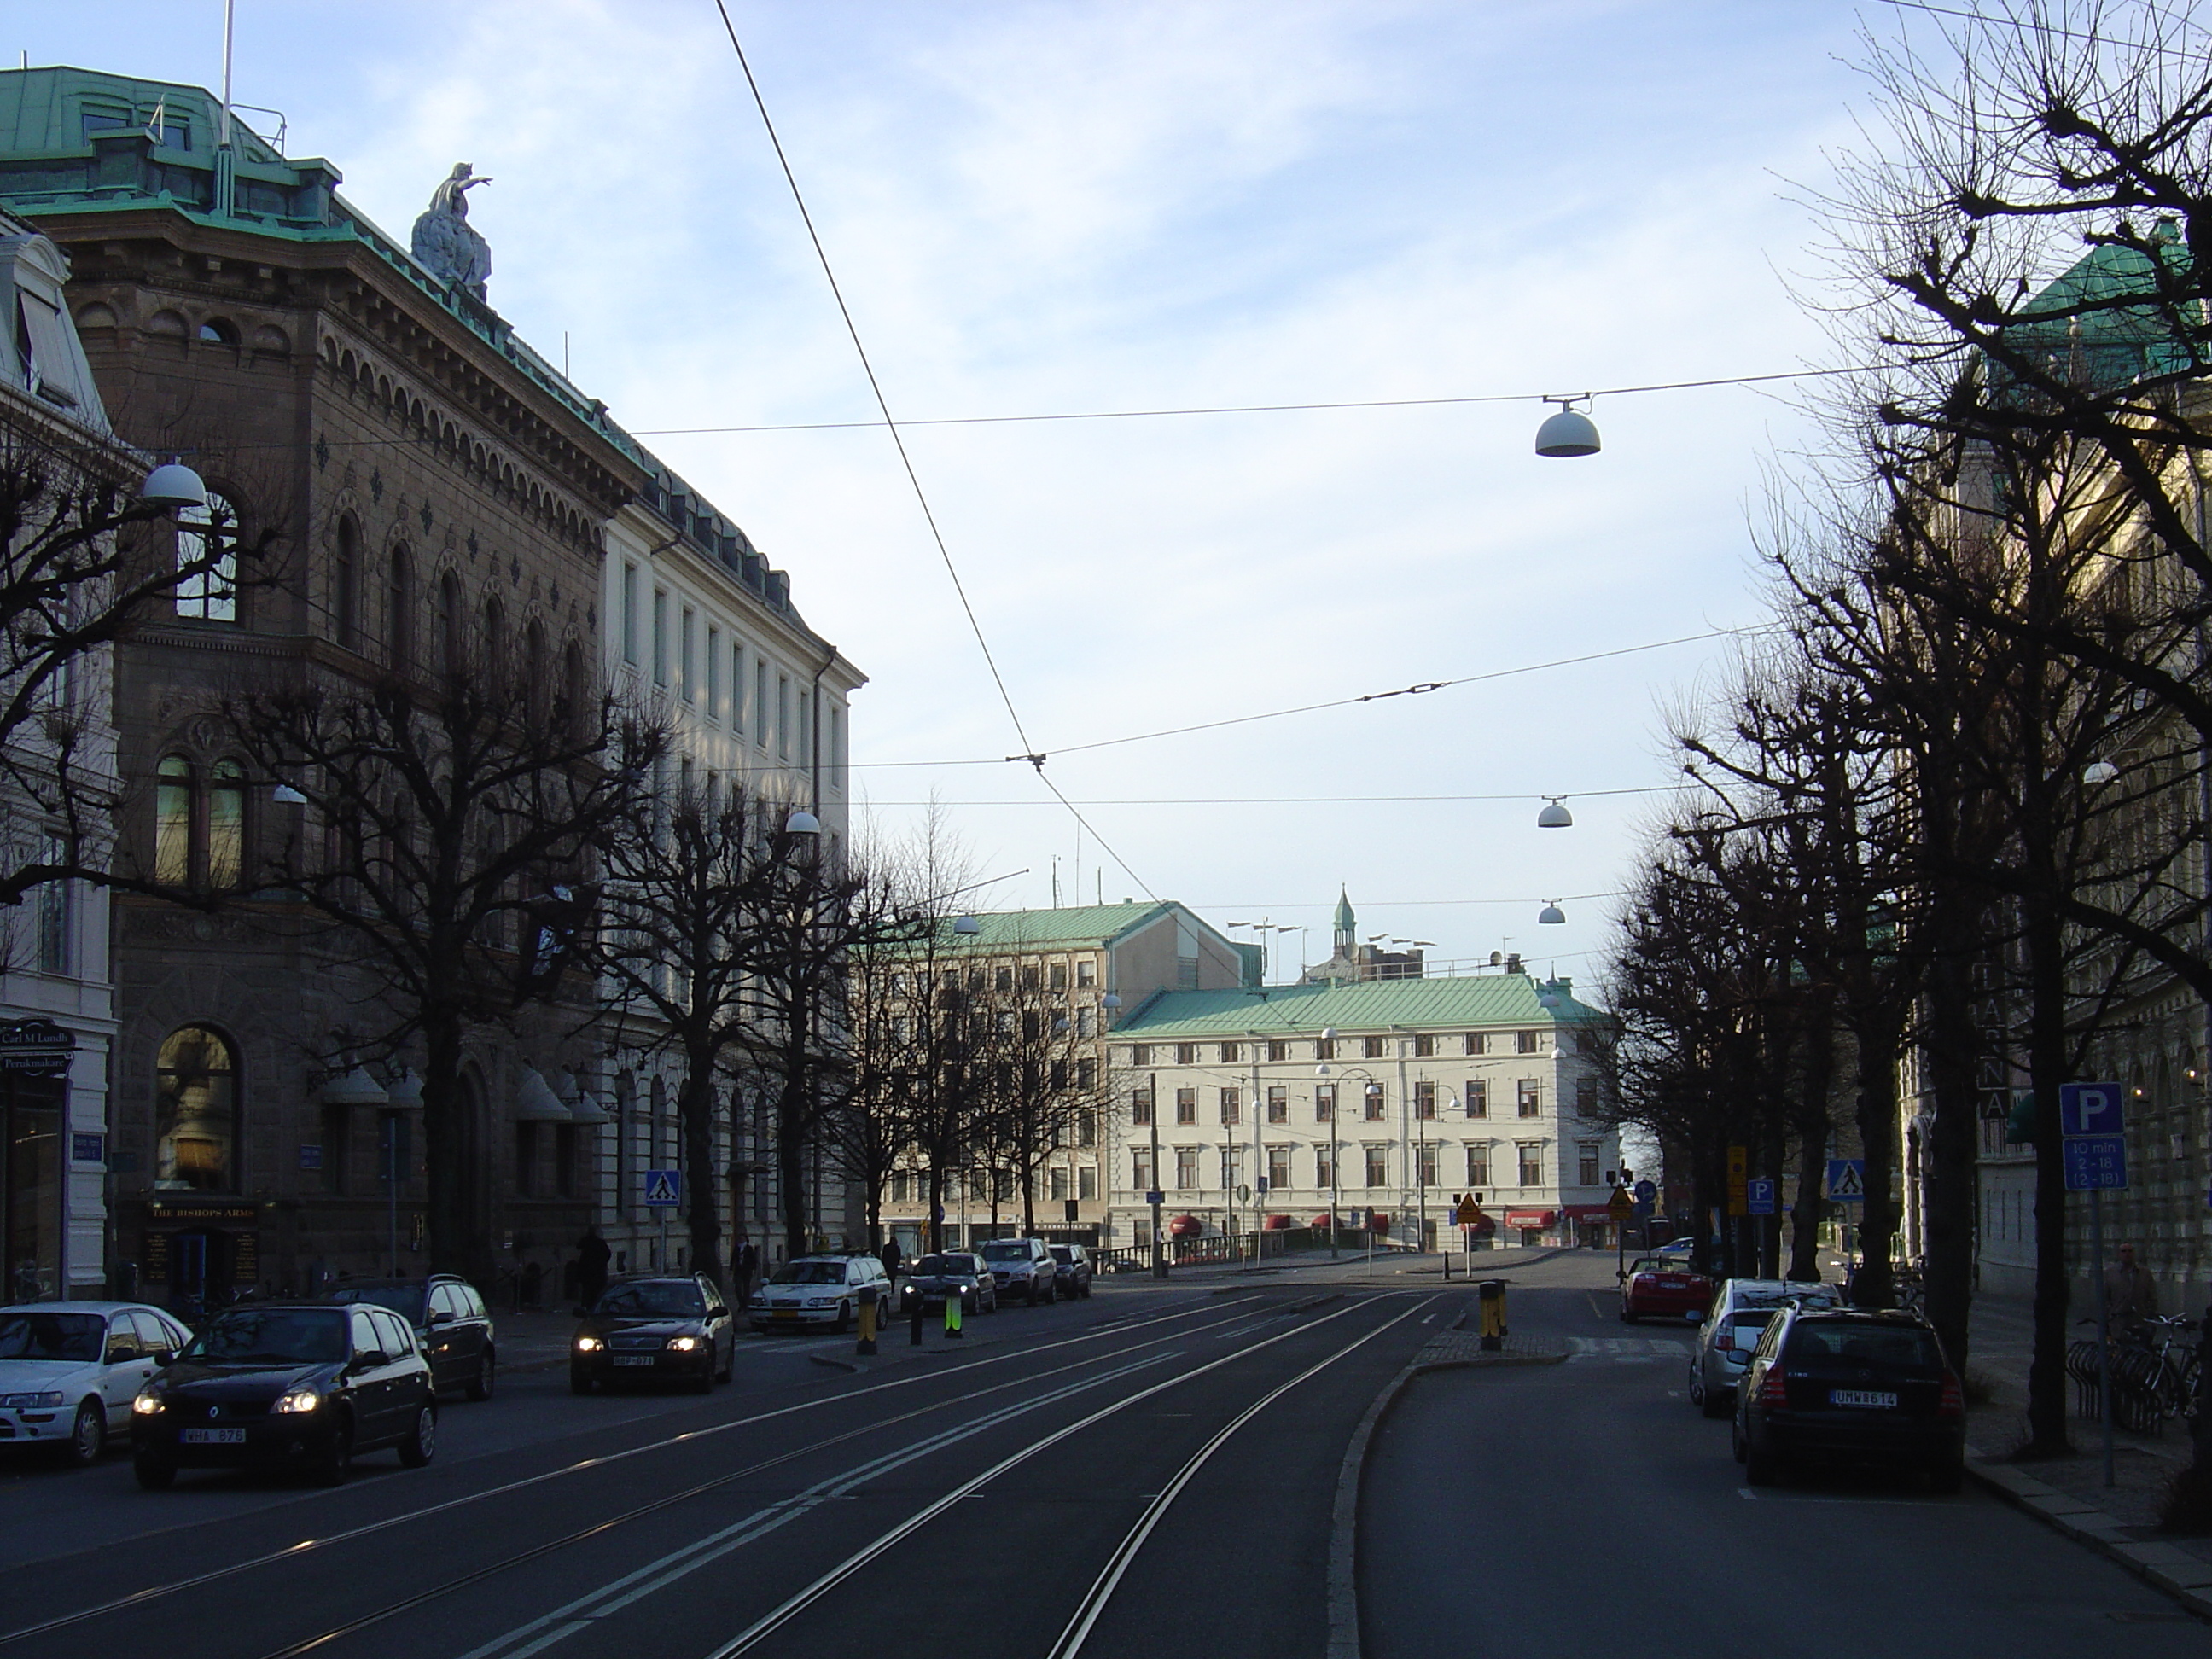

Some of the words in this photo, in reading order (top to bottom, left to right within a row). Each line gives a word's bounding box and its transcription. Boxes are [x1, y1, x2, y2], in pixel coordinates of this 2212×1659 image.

[2, 1032, 22, 1043] Carl
[25, 1033, 35, 1043] M
[38, 1032, 68, 1043] Lundh
[5, 1057, 65, 1068] Perukmakare
[2079, 1090, 2108, 1131] P
[2074, 1143, 2088, 1154] 10
[2093, 1143, 2116, 1154] min
[1755, 1183, 1768, 1199] P
[154, 1208, 172, 1218] THE
[177, 1208, 222, 1218] BISHOPS
[224, 1208, 254, 1218] ARMS
[1837, 1390, 1860, 1404] UMW
[1871, 1393, 1895, 1406] 614
